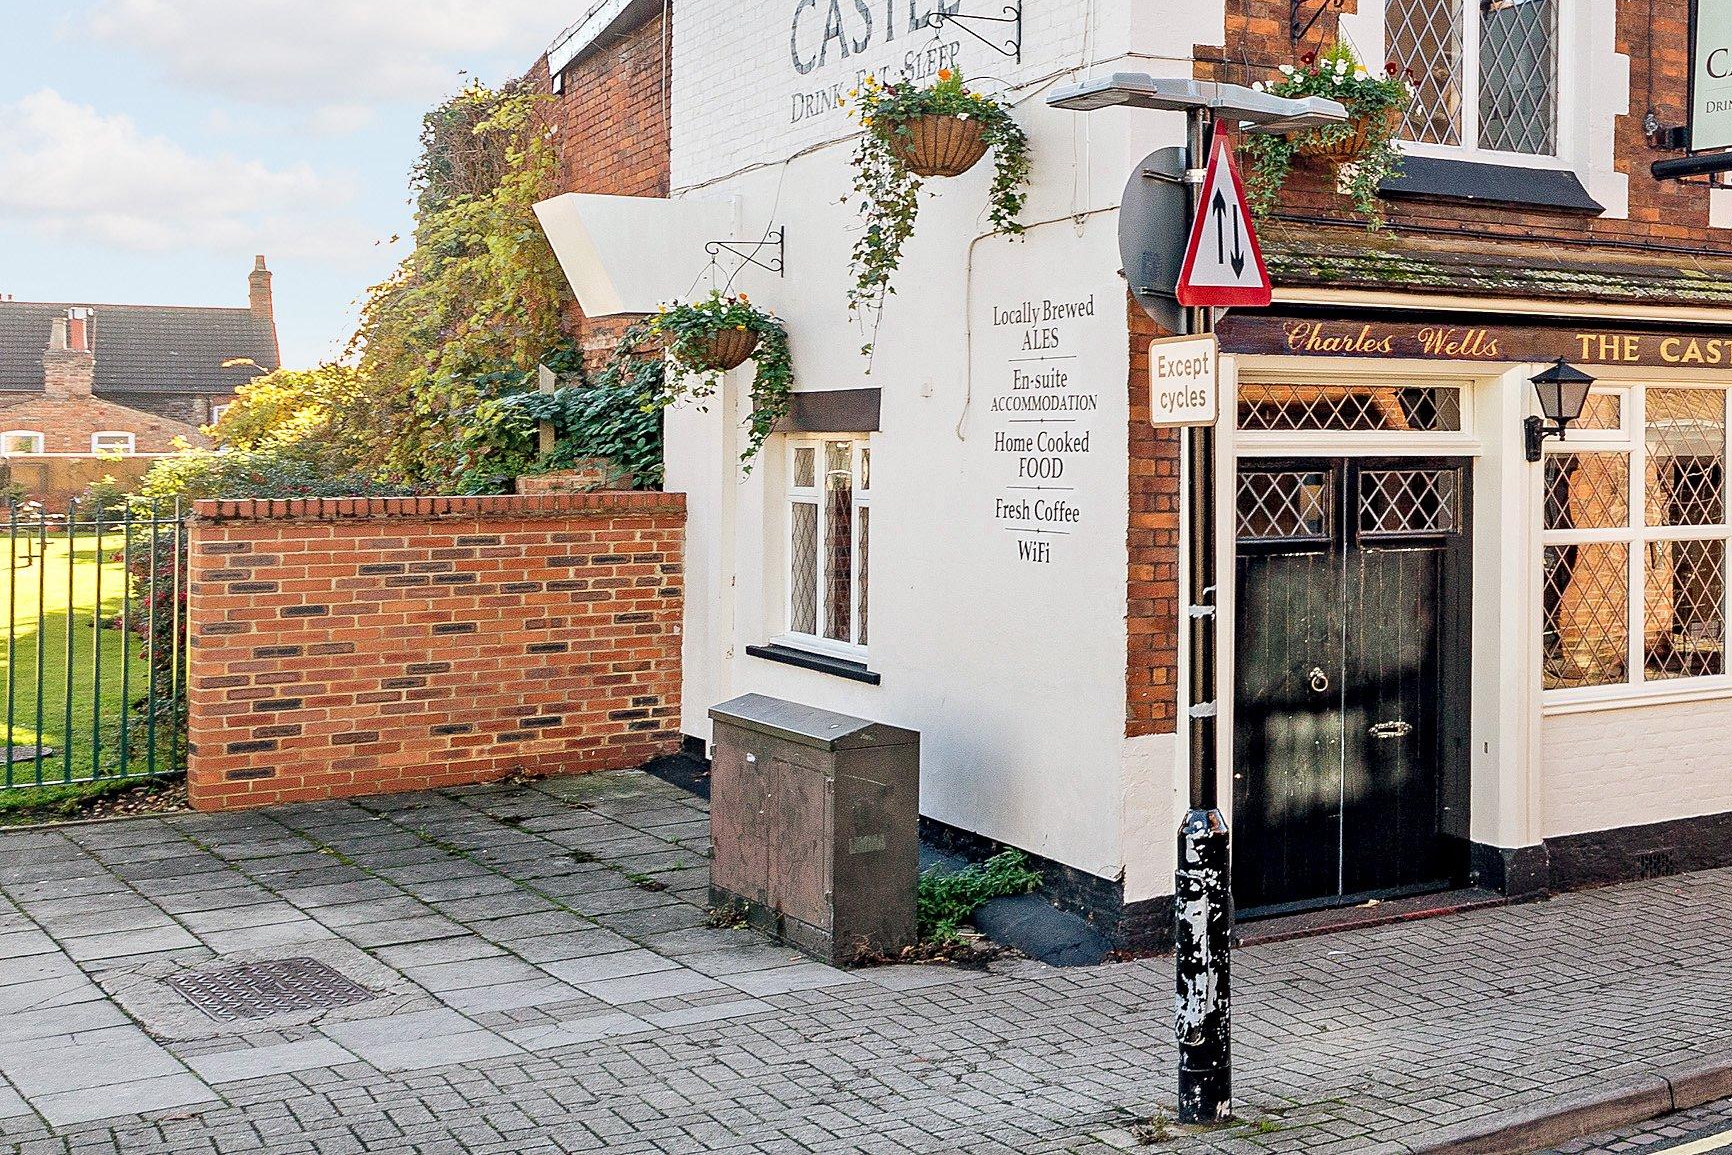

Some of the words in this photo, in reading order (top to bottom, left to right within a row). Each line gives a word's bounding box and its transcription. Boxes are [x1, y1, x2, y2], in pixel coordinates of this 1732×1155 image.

[993, 301, 1040, 330] Locally
[1042, 294, 1095, 322] Brewed
[1021, 327, 1060, 351] ALES
[1282, 322, 1394, 353] Charles
[1413, 326, 1499, 357] Wells
[1575, 333, 1641, 361] THE
[1158, 352, 1209, 379] Except
[1013, 368, 1068, 391] En-suite
[990, 394, 1098, 412] ACCOMMODATION
[1160, 385, 1206, 413] cycles
[994, 431, 1033, 453] Home
[1037, 430, 1090, 453] Cooked
[1019, 457, 1064, 479] FOOD
[995, 498, 1031, 521] Fresh
[1034, 499, 1080, 523] Coffee
[1017, 540, 1051, 564] WiFi
